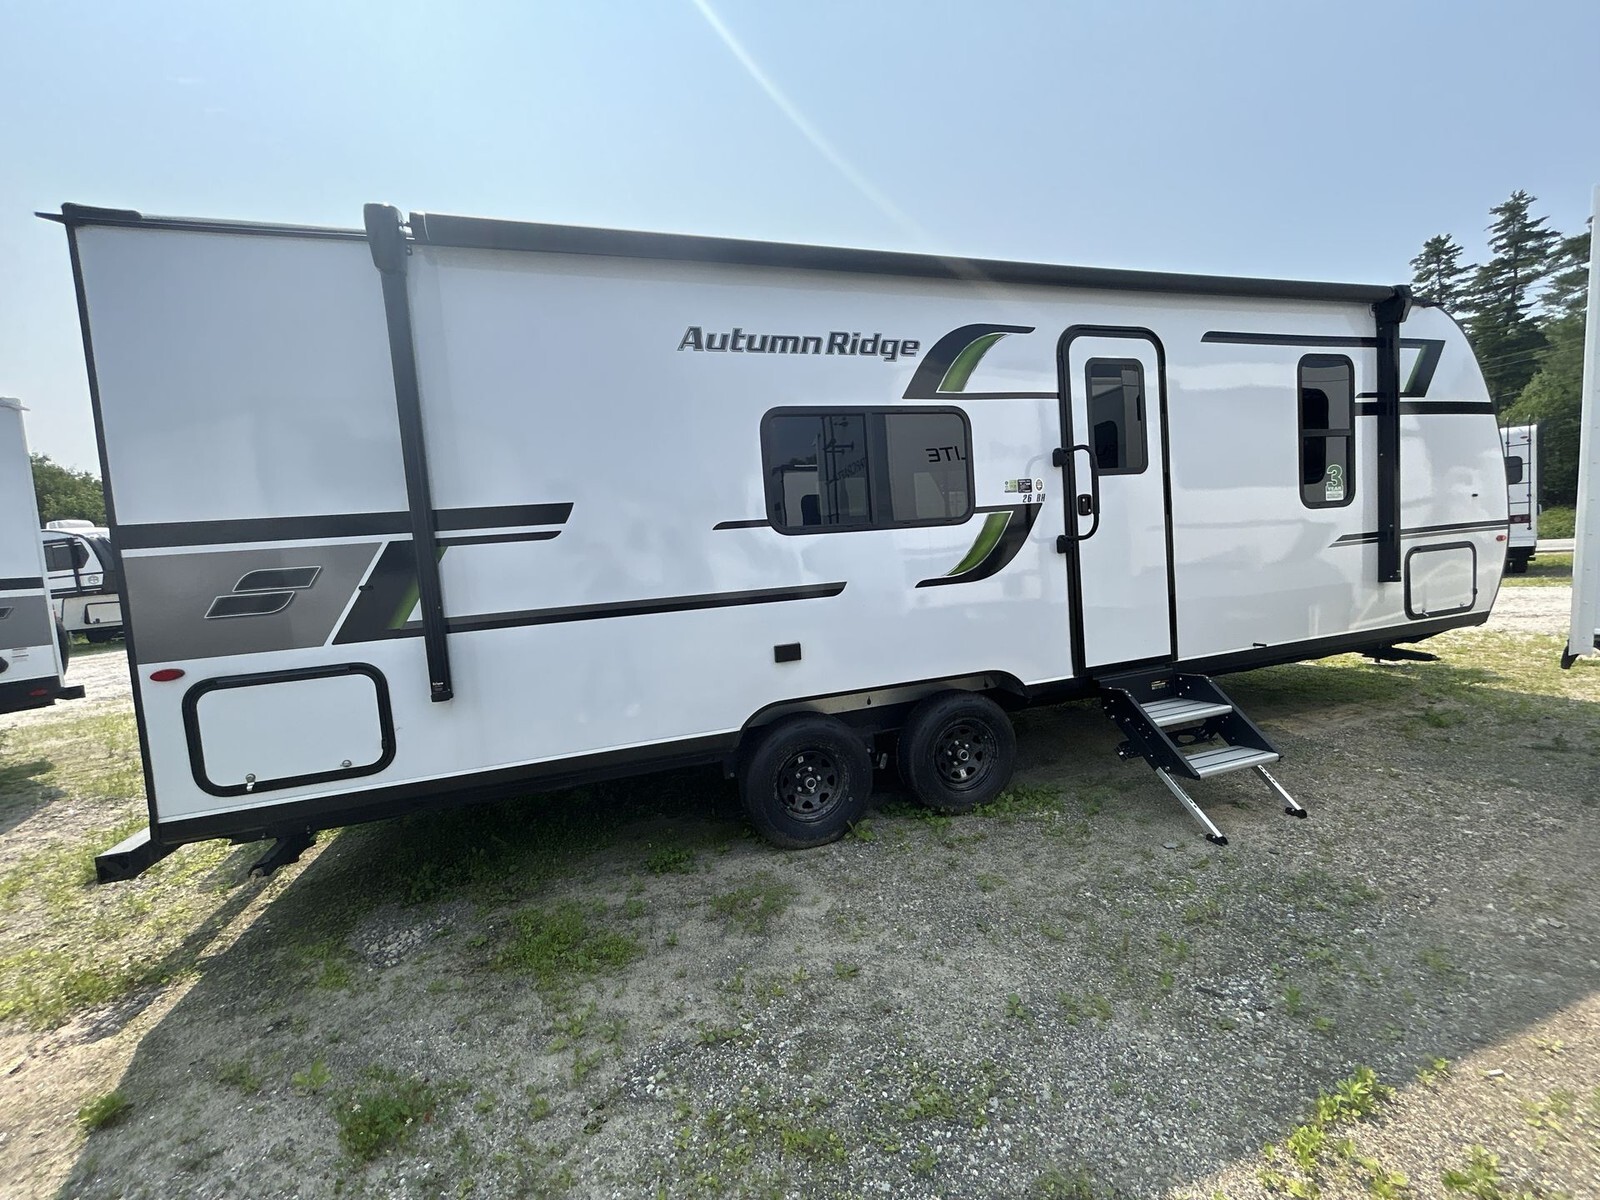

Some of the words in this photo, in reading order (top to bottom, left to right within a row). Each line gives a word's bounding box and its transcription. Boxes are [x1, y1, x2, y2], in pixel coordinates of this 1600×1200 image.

[678, 326, 823, 354] Autumn
[825, 331, 921, 362] Ridge
[1326, 464, 1343, 487] 3
[1022, 494, 1032, 503] 26
